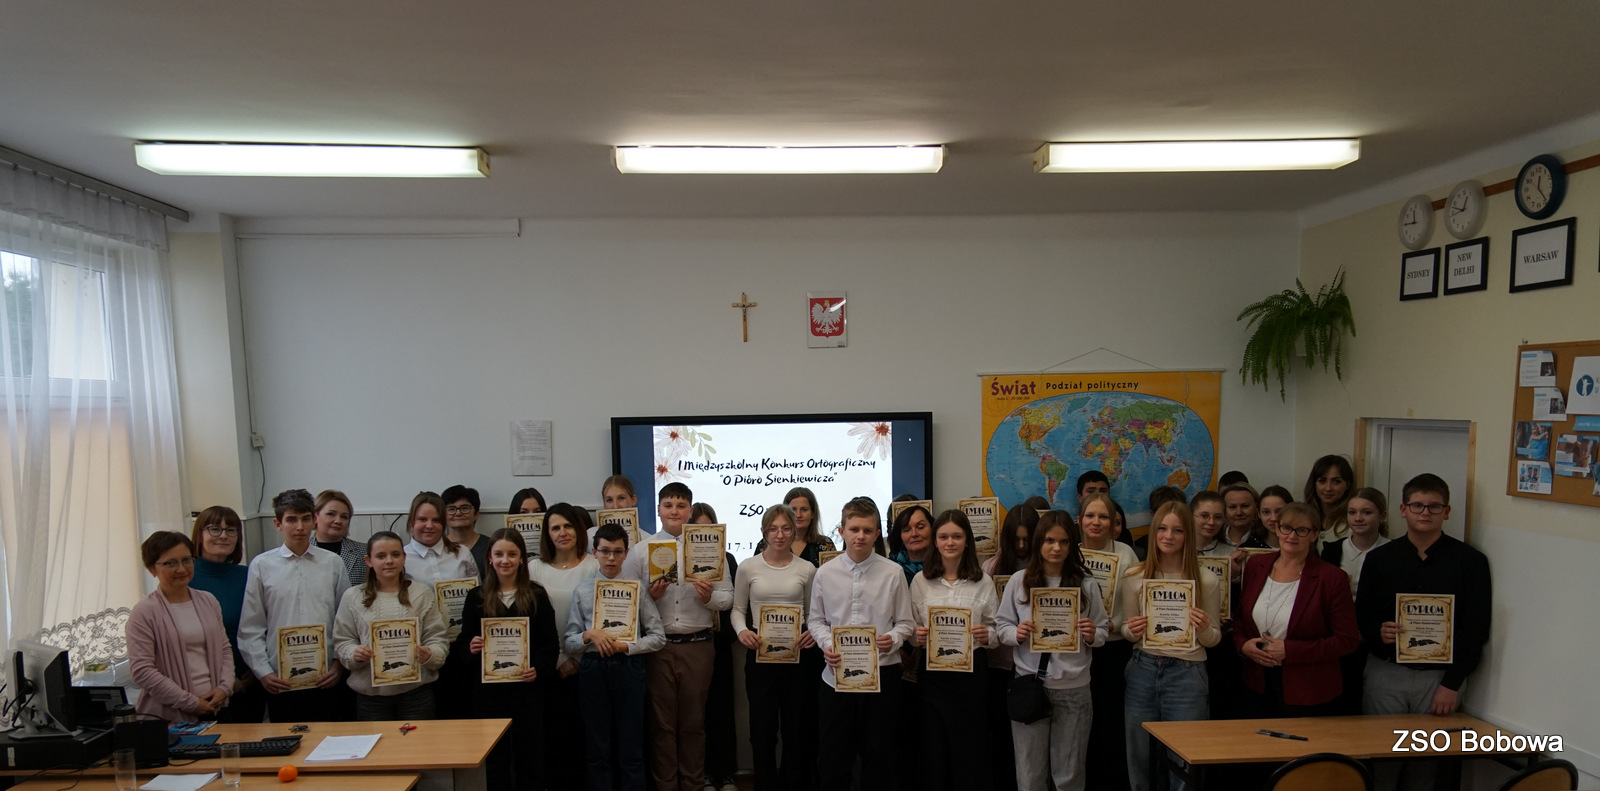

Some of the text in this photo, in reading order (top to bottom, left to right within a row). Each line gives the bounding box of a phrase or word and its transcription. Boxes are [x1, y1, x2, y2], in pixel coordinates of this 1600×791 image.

[1456, 252, 1473, 263] NEW
[1523, 250, 1559, 264] WARSAW
[1407, 269, 1431, 279] SYDNEY
[1453, 265, 1475, 277] DELHI
[991, 377, 1036, 396] Świat
[1046, 380, 1139, 391] Podział polityczny
[684, 458, 759, 473] Międzyszkolny
[761, 457, 805, 470] Konkurs
[806, 457, 876, 471] Ortograficzny
[734, 473, 763, 487] Pióro
[739, 503, 764, 517] ZSO
[690, 534, 719, 542] DYPLOM
[603, 589, 632, 598] DYPLOM
[1153, 591, 1186, 600] DYPLOM
[1039, 597, 1072, 606] DYPLOM
[1407, 604, 1444, 614] DYPLOM
[766, 614, 795, 623] DYPLOM
[936, 616, 966, 625] DYPLOM
[379, 628, 411, 638] DYPLOM
[490, 628, 521, 636] DYPLOM
[287, 635, 319, 645] DYPLOM
[840, 635, 871, 645] DYPLOM
